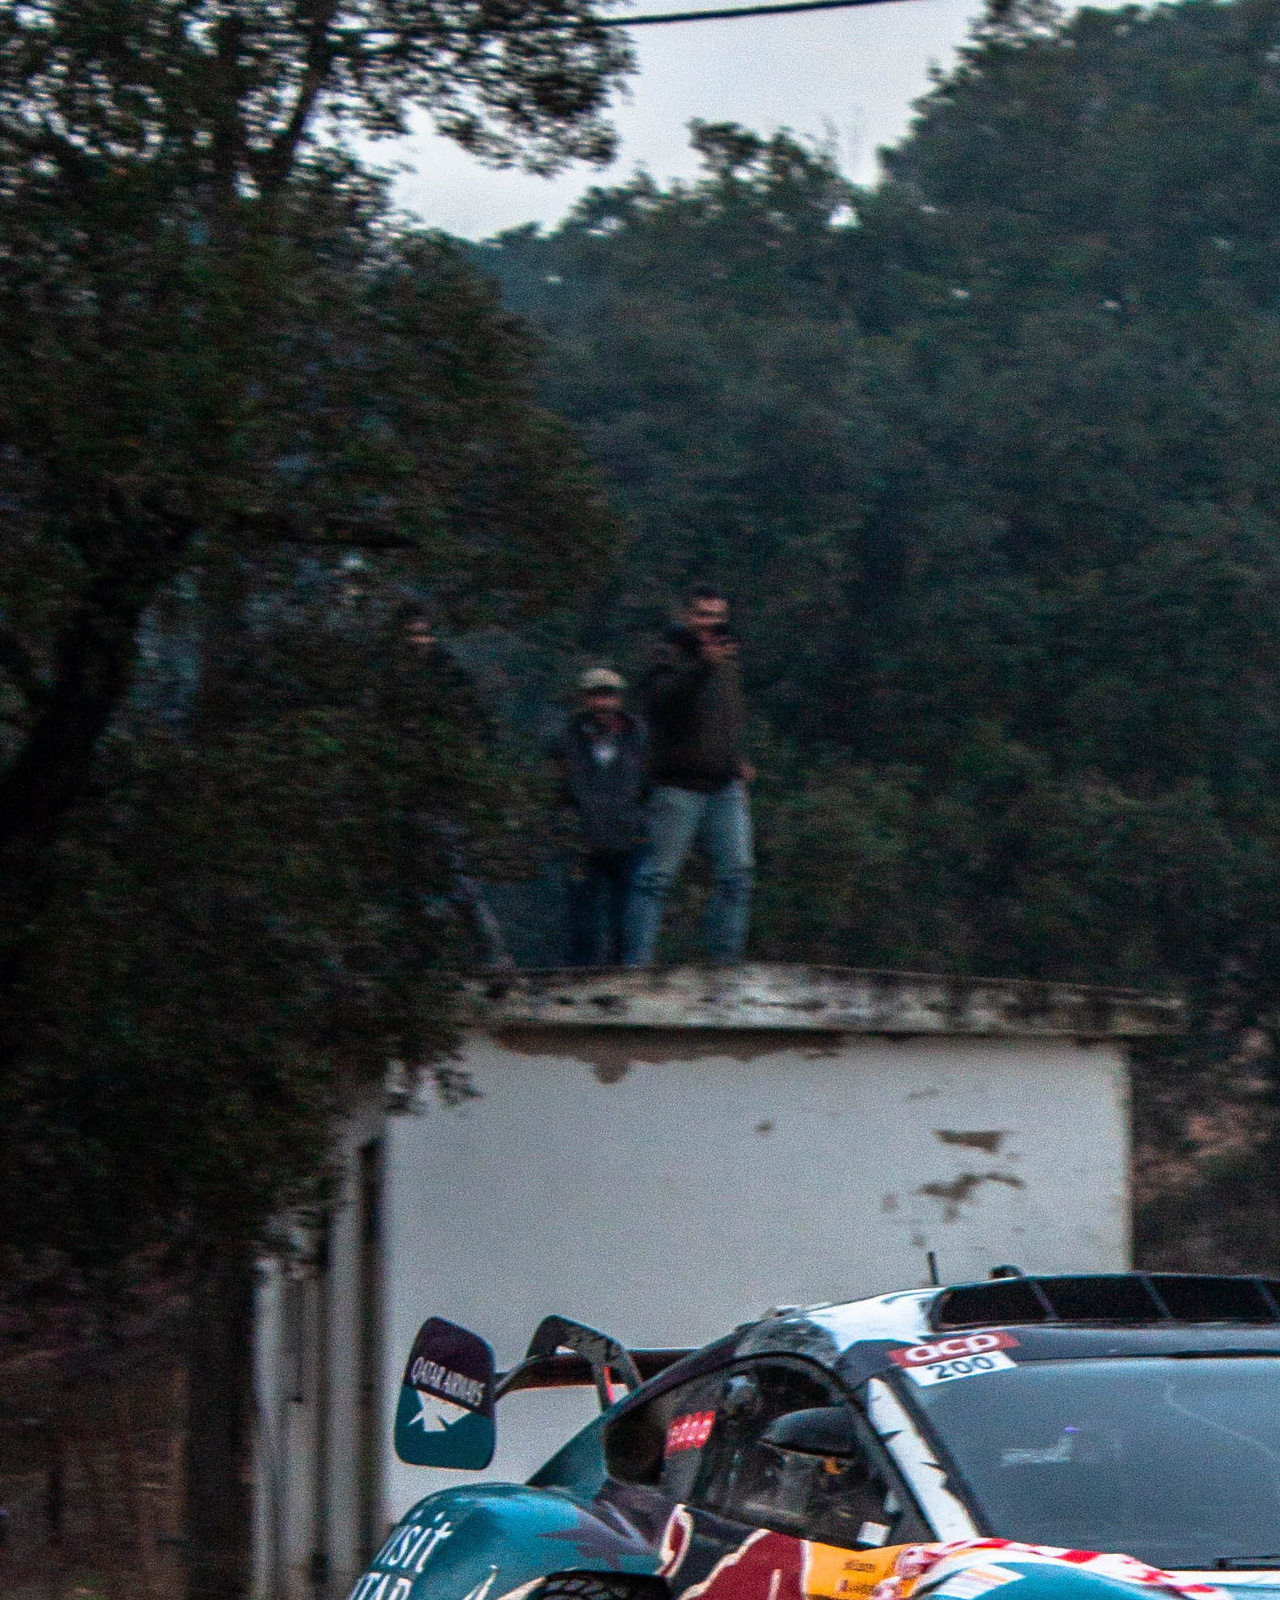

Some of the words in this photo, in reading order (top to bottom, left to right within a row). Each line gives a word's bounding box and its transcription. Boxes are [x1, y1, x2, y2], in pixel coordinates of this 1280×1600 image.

[904, 1334, 999, 1362] acp
[410, 1356, 447, 1390] QATAR
[926, 1355, 995, 1380] 200
